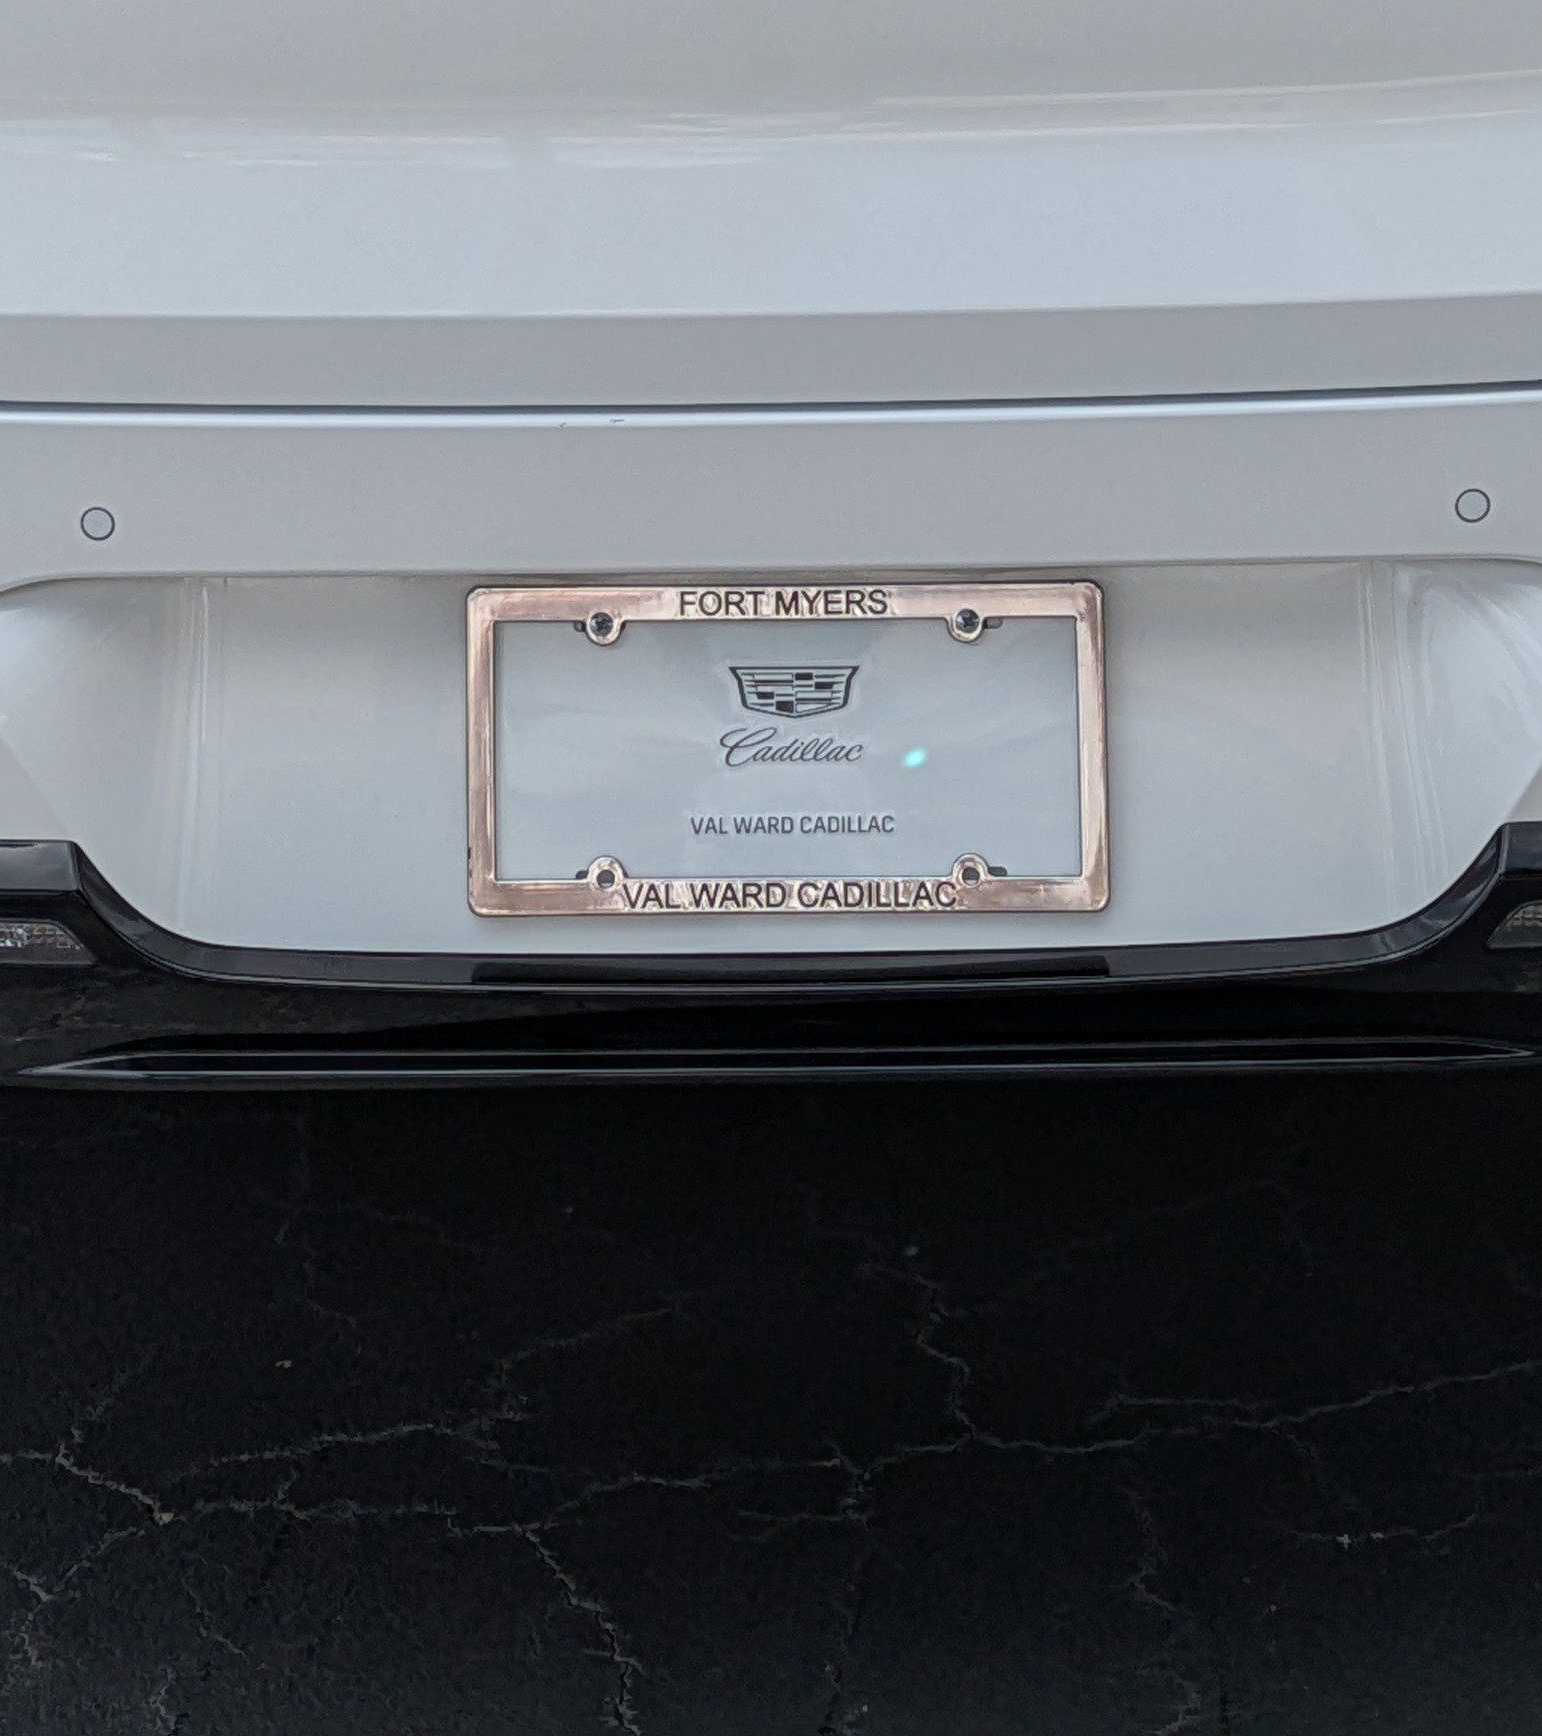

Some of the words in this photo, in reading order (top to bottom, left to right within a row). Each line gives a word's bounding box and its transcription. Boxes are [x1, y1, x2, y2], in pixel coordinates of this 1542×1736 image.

[679, 591, 765, 615] FORT
[775, 589, 888, 615] MYERS
[719, 726, 863, 767] Cadillac
[690, 816, 728, 835] VAL
[733, 816, 794, 834] WARD
[800, 815, 895, 834] CADILLAC
[622, 882, 681, 909] VAL
[690, 882, 787, 909] WARD
[797, 881, 957, 907] CADILLAC
